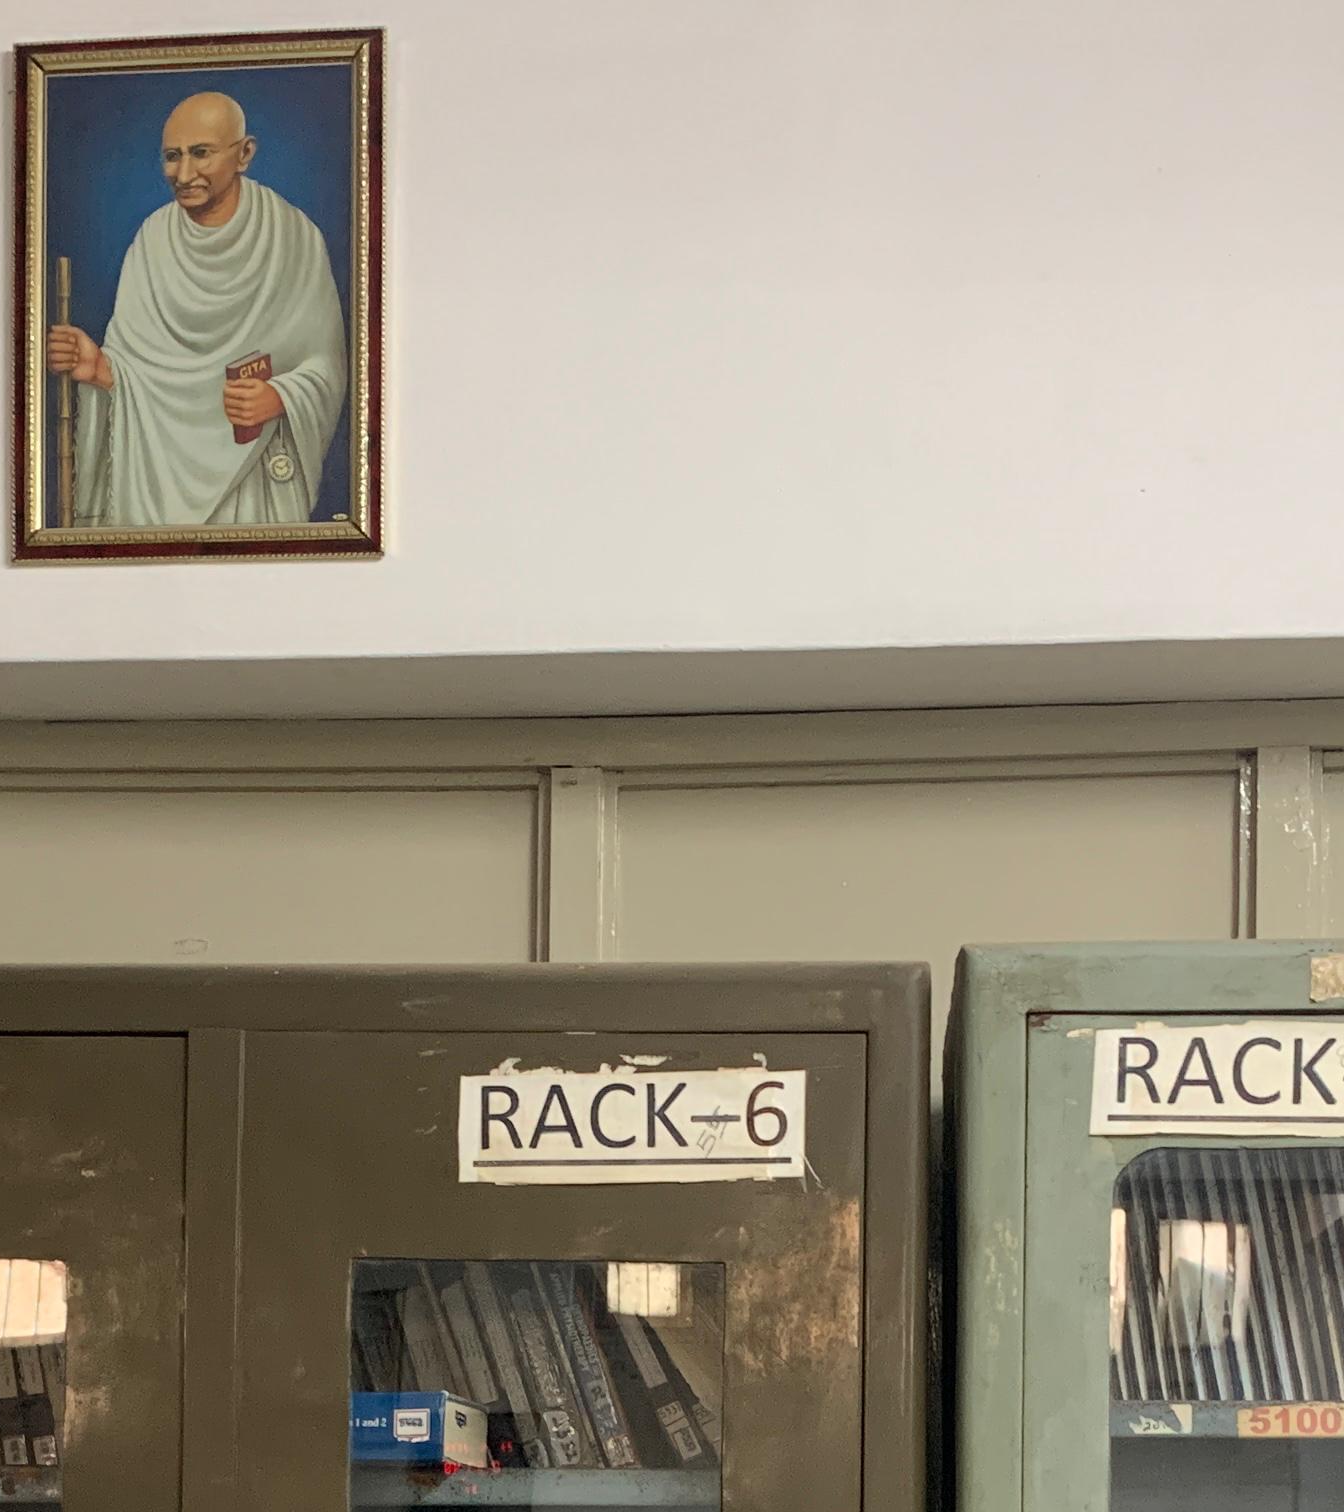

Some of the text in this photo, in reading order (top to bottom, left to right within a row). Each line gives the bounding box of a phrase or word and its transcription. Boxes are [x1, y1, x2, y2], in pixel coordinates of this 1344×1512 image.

[240, 360, 266, 378] GITA
[480, 1081, 788, 1150] RACK-6
[361, 1417, 379, 1427] and
[1249, 1407, 1343, 1435] 5100
